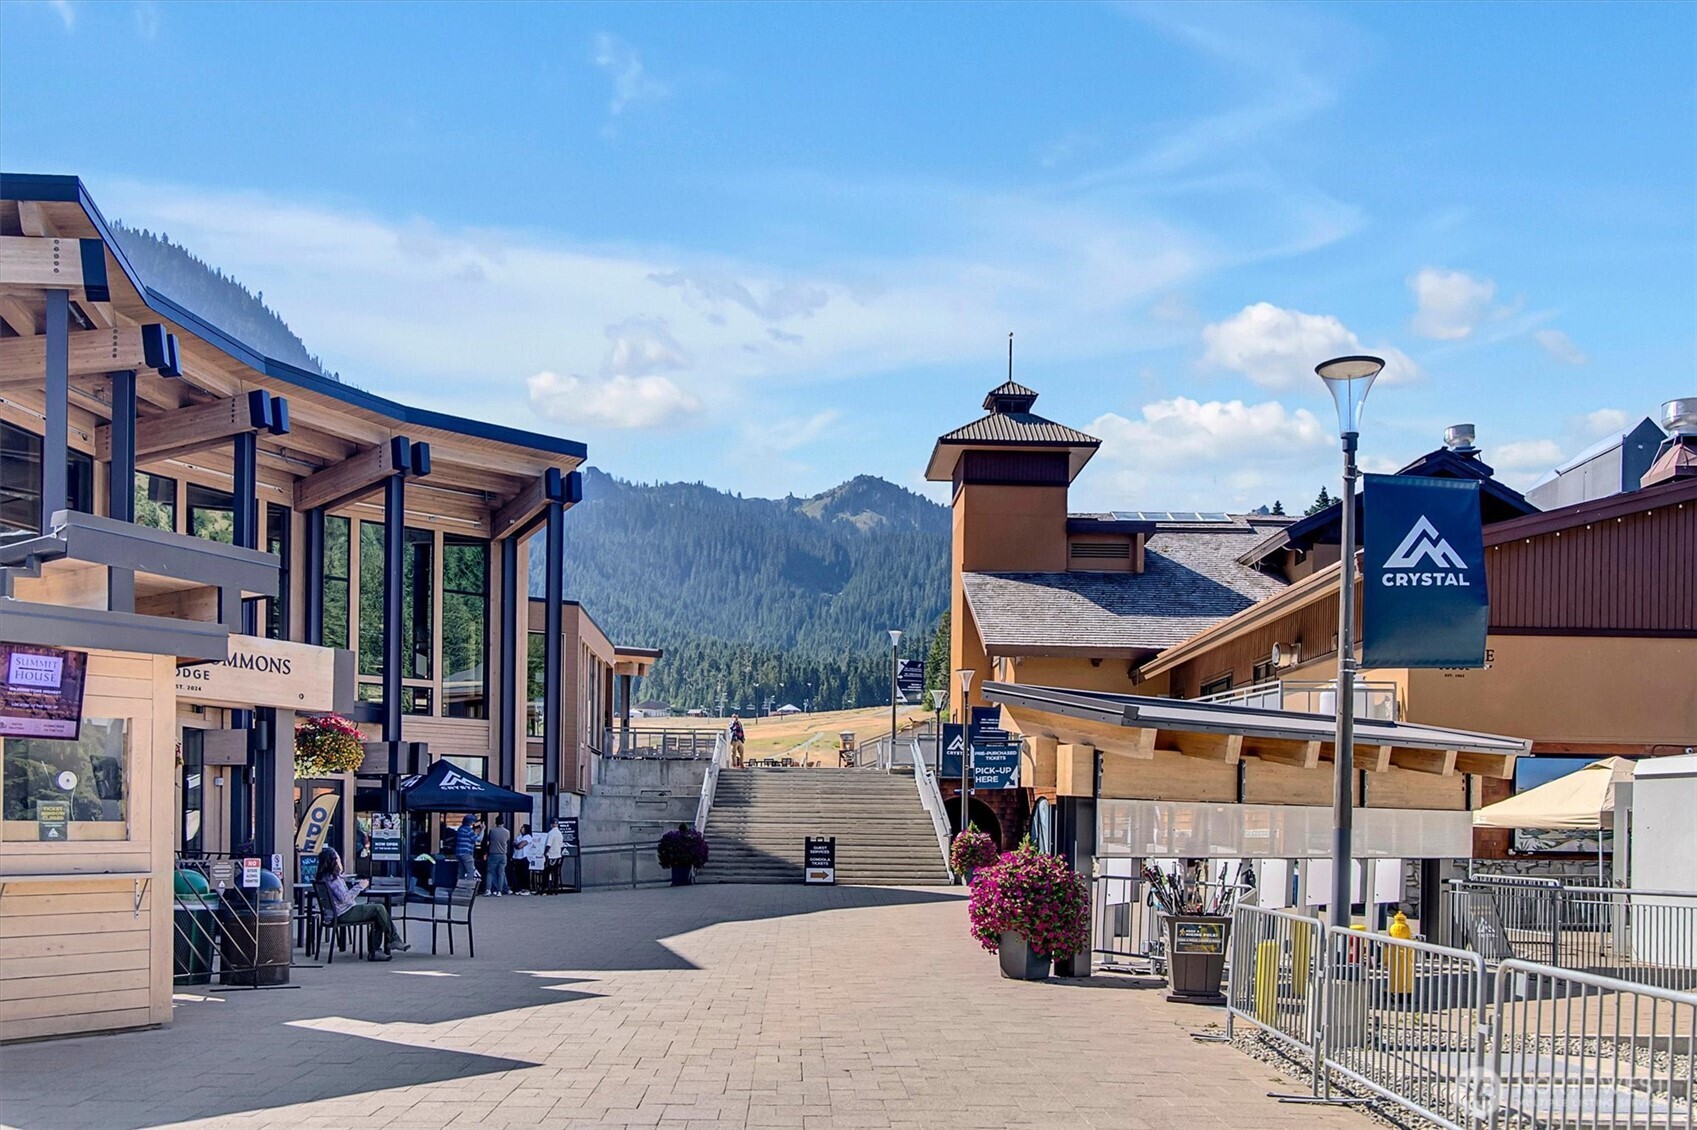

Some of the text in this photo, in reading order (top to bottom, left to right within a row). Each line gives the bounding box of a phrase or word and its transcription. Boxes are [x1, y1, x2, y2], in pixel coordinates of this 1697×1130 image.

[1382, 572, 1470, 587] CRYSTAL
[15, 657, 58, 669] SUMMIT
[211, 652, 291, 675] MMONS
[15, 670, 57, 682] HOUSE
[975, 766, 1012, 774] PICK-UP
[975, 775, 999, 783] HERE
